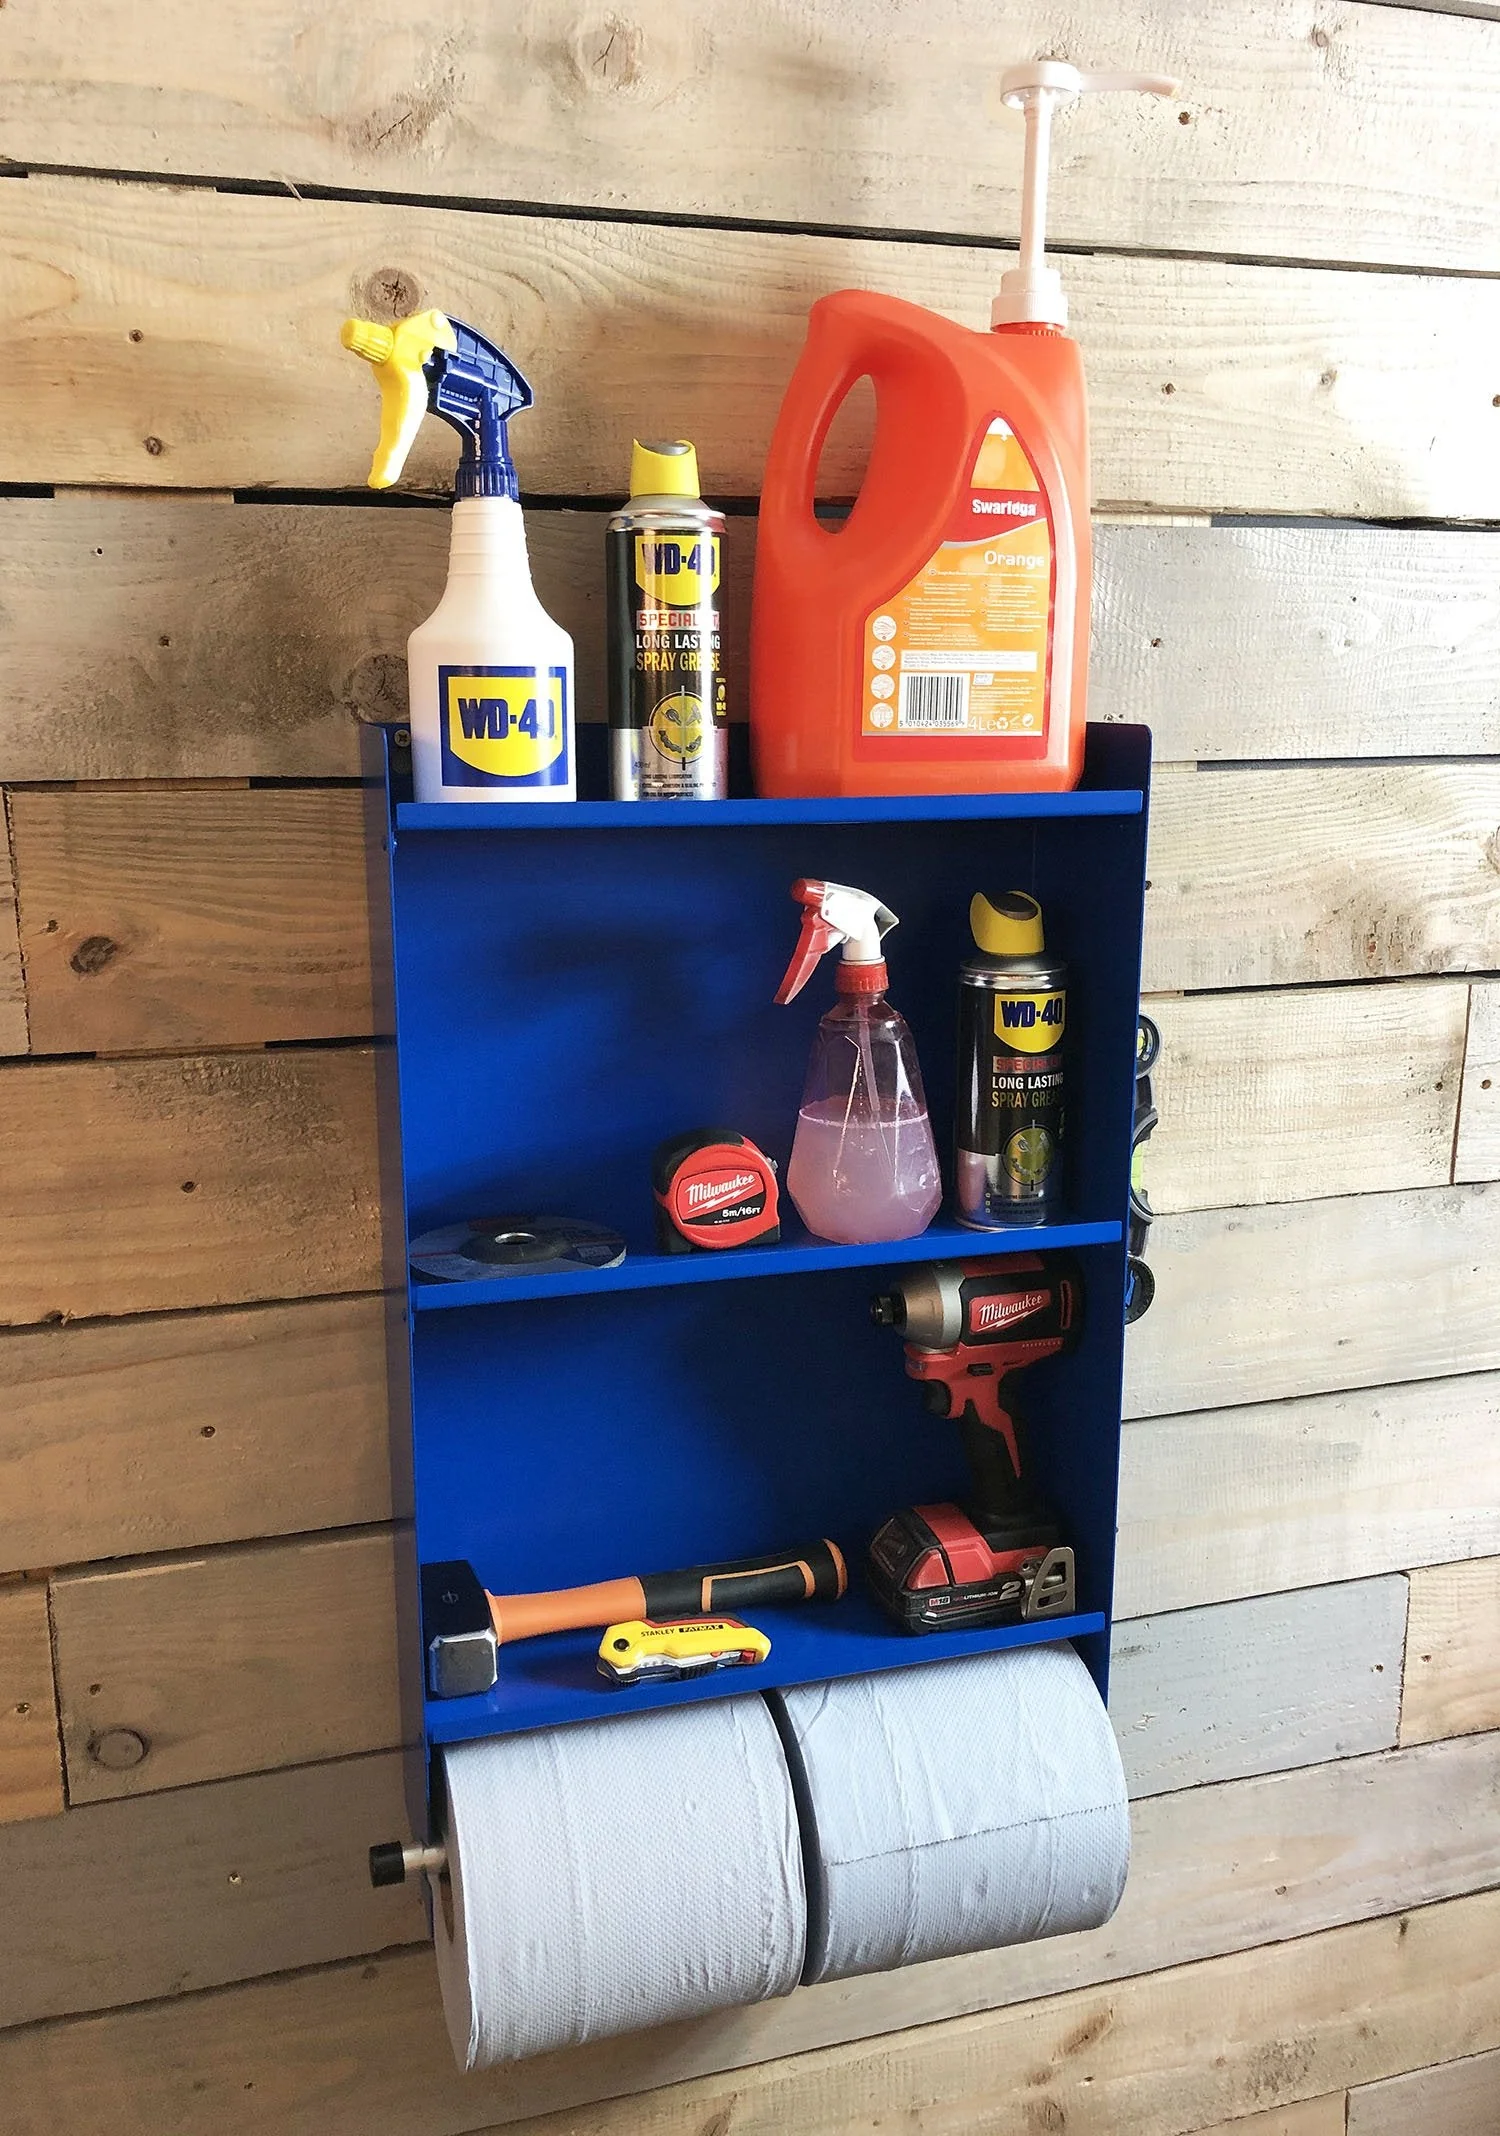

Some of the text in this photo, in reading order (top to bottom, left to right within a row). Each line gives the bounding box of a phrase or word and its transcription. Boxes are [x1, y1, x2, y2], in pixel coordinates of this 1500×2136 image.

[984, 550, 1045, 570] Orange
[640, 613, 718, 627] SPECIALT
[636, 634, 720, 649] LONG LASTNG
[636, 652, 720, 671] SPRAY GRESE
[1001, 998, 1063, 1028] WD-40
[996, 1055, 1062, 1071] SPECIA
[992, 1072, 1063, 1090] LONG LASTING
[991, 1089, 1059, 1108] SPRAY GRE
[685, 1174, 755, 1206] Milwaukee
[979, 1295, 1042, 1325] Milwaukee
[641, 1628, 675, 1637] STANLEY
